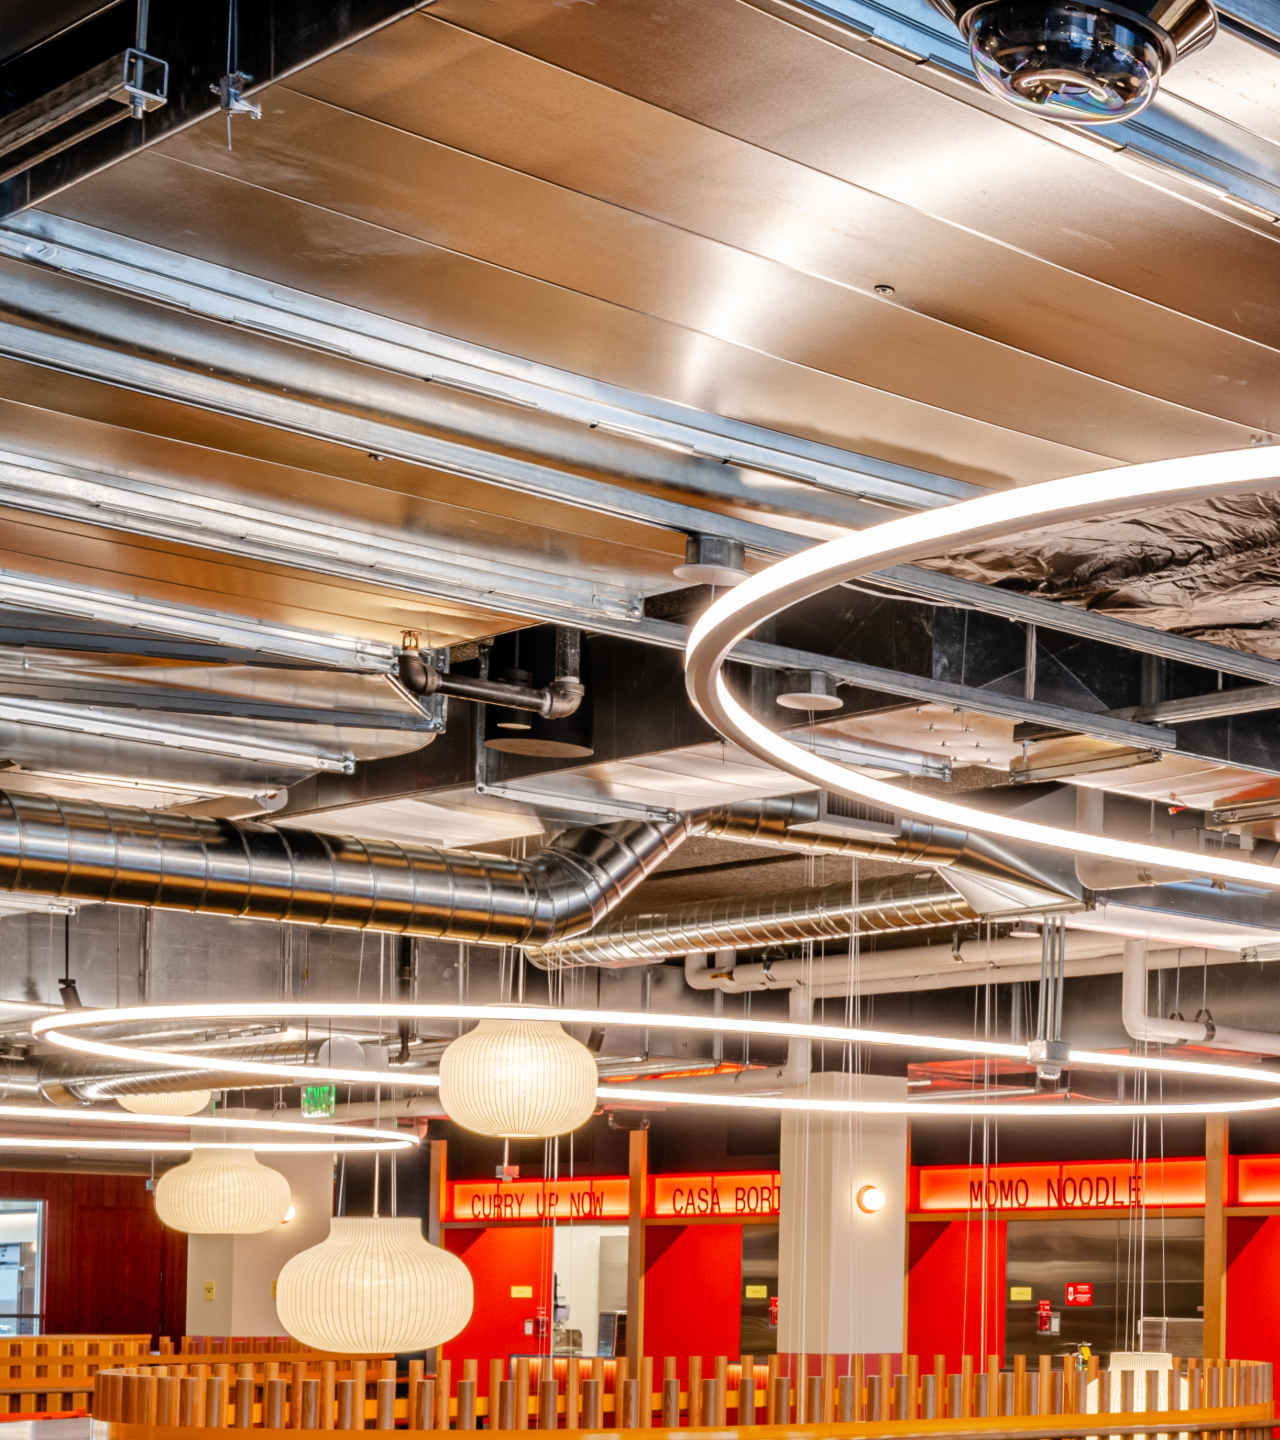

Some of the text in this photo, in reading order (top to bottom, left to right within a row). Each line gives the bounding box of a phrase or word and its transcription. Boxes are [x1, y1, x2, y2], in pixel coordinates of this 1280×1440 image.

[471, 1191, 605, 1218] CURRY UP NOW
[672, 1187, 721, 1214] CASA
[969, 1176, 1142, 1208] MOMO NOODLE
